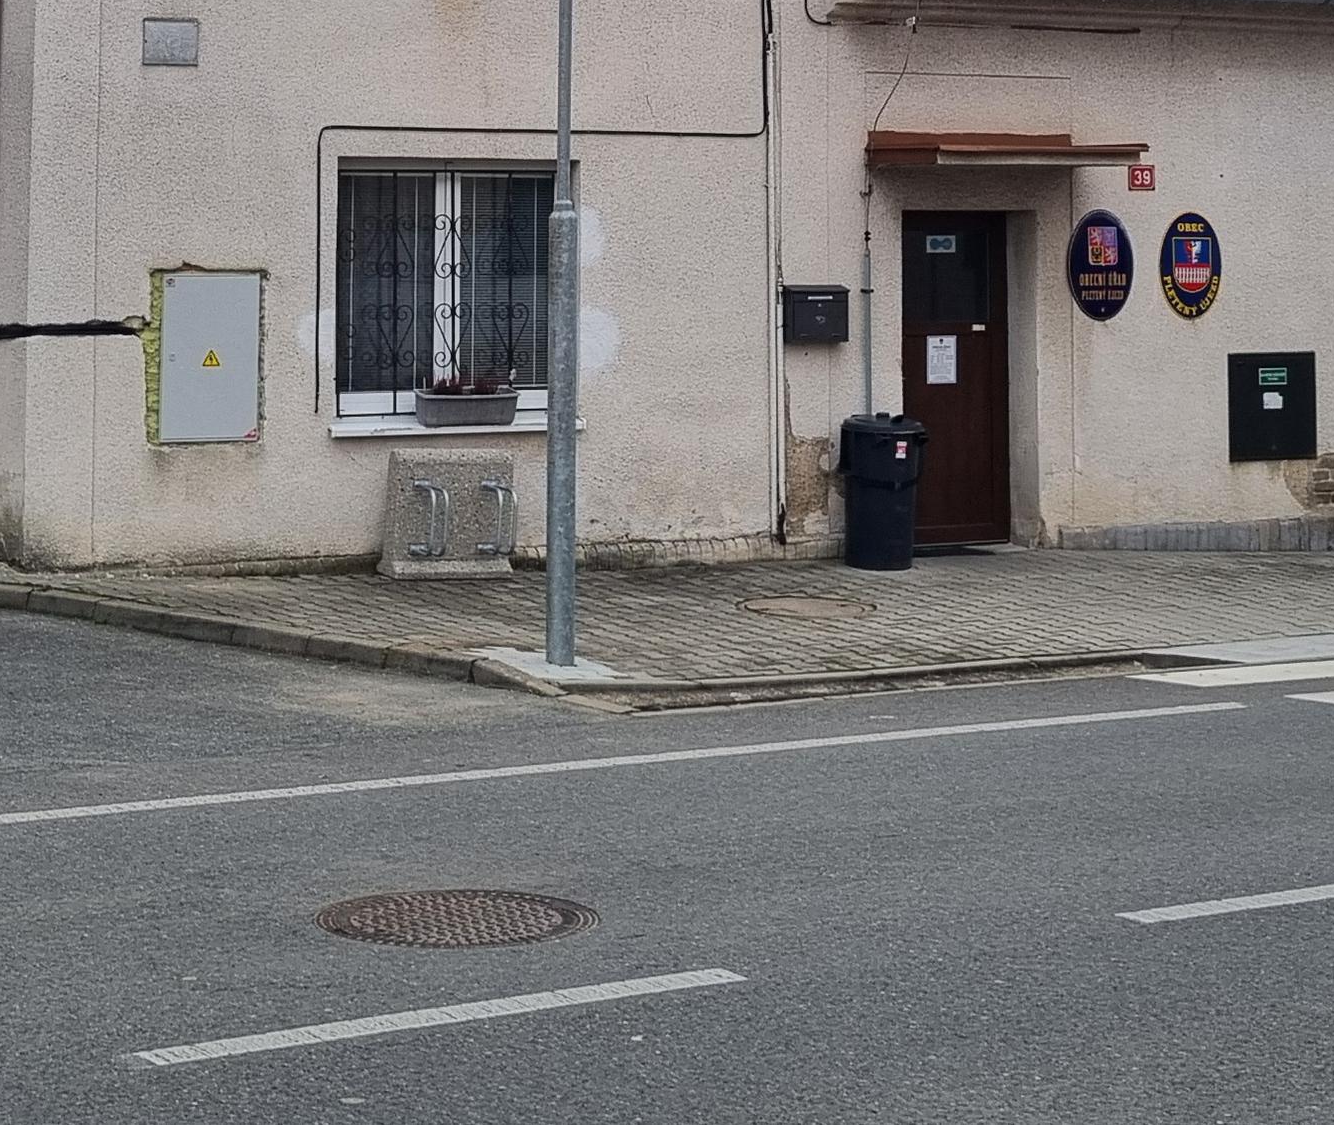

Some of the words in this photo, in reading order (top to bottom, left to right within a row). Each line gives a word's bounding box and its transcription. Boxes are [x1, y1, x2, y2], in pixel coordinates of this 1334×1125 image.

[1134, 170, 1151, 185] 39
[1176, 222, 1205, 233] OBEC
[1078, 271, 1107, 287] OBECNÍ
[1163, 275, 1197, 316] PLETENÝ
